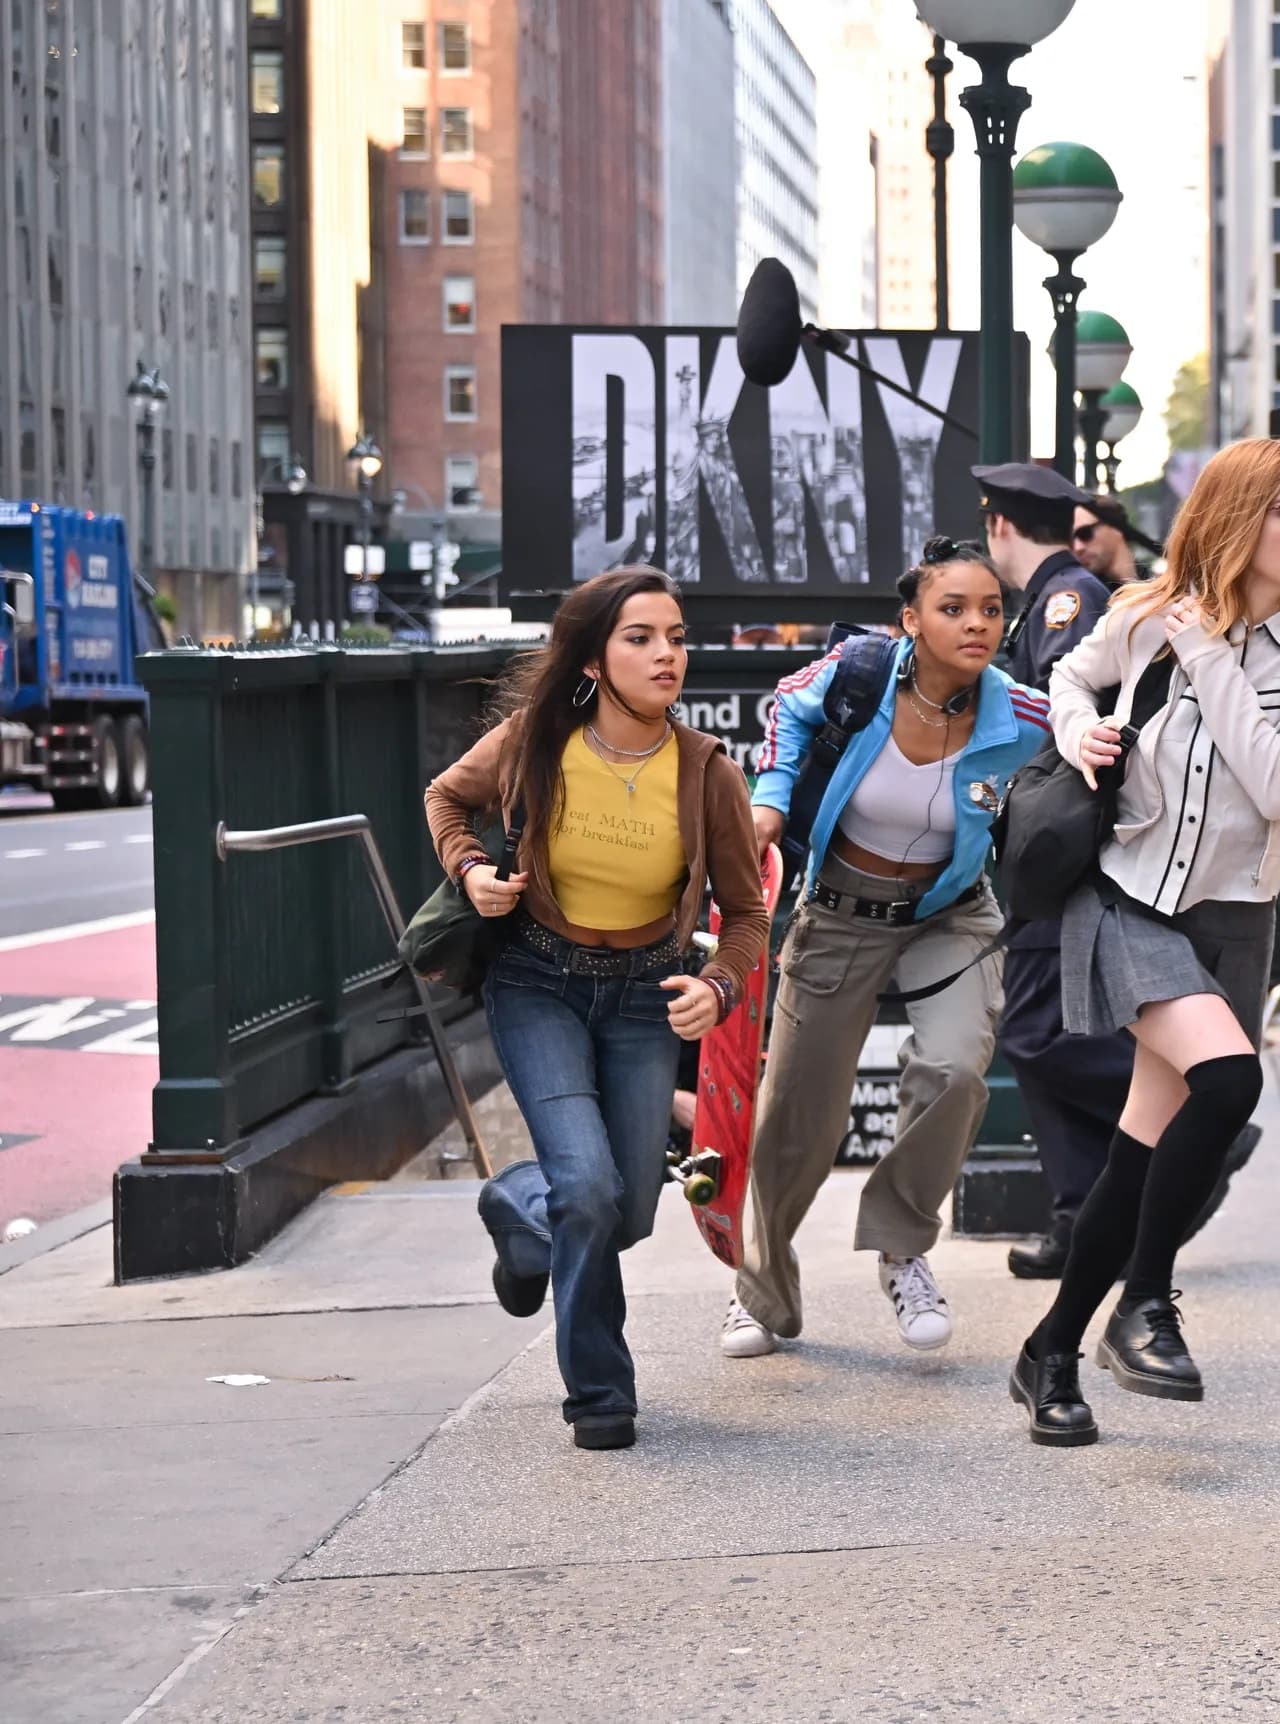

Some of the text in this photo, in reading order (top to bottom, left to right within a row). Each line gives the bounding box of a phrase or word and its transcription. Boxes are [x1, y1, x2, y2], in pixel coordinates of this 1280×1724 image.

[571, 333, 963, 584] DKNY
[675, 694, 740, 729] and
[568, 810, 656, 836] eat MATH
[581, 826, 649, 850] breakfast
